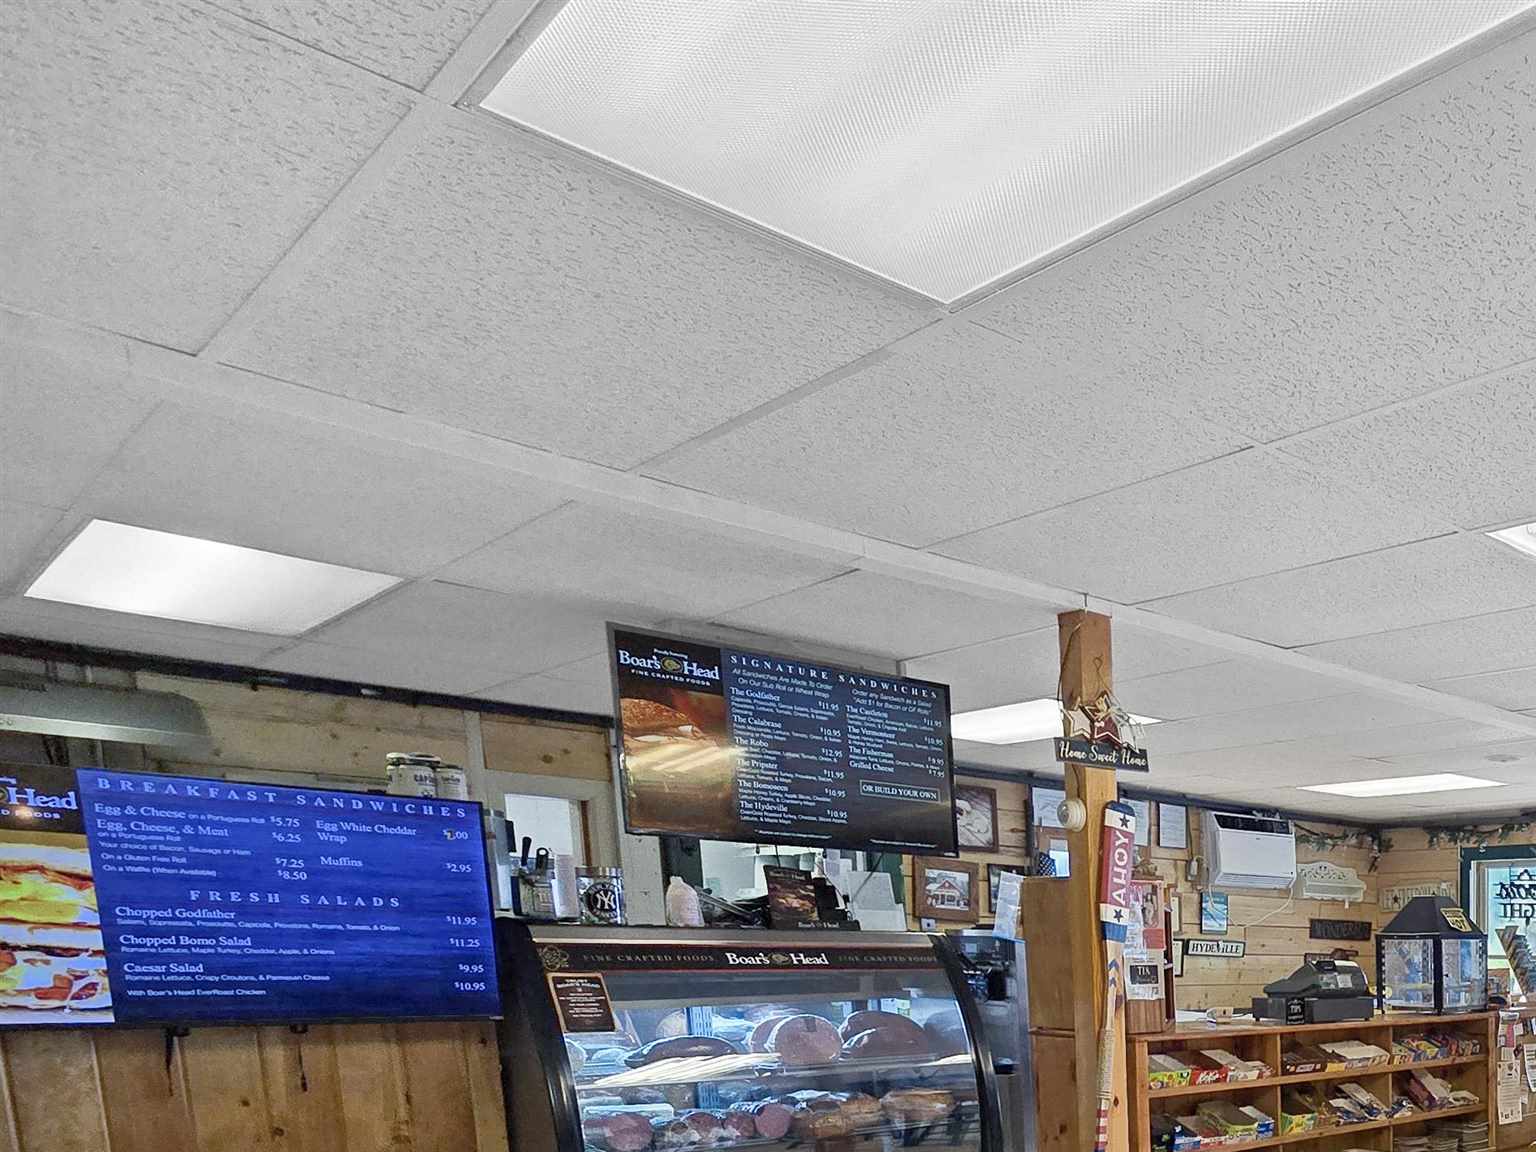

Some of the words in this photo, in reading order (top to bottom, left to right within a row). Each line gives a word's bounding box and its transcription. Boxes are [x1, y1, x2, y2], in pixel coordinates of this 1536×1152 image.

[618, 649, 661, 670] Boar's
[682, 660, 720, 680] Head
[651, 671, 685, 682] CRAFTED
[730, 655, 829, 680] SIGNATURE
[838, 674, 937, 699] SANDWICHES
[729, 686, 745, 697] The
[818, 700, 840, 712] $11.95
[732, 714, 746, 725] The
[734, 736, 749, 746] The
[1060, 740, 1088, 760] Home
[1088, 744, 1120, 764] Sweet
[1120, 747, 1147, 767] Home
[736, 758, 750, 767] The
[738, 778, 752, 788] The
[862, 784, 874, 792] OR
[874, 786, 898, 795] BUILD
[898, 788, 919, 798] YOUR
[919, 791, 938, 799] OWN
[6, 786, 79, 810] Head
[97, 778, 278, 803] BREAKFAST
[296, 794, 466, 818] SANDWICHES
[740, 799, 753, 809] The
[94, 802, 121, 816] Egg
[124, 805, 138, 816] &
[140, 806, 187, 819] Cheese
[270, 815, 300, 828] $5.75
[315, 819, 339, 833] Egg
[339, 821, 373, 834] White
[373, 823, 417, 836] Cheddar
[130, 820, 180, 835] Cheese,
[182, 824, 196, 835] &
[197, 825, 230, 837] Meat
[271, 831, 302, 843] $6.25
[317, 831, 348, 844] Wrap
[275, 856, 305, 868] $7.25
[319, 855, 364, 868] Muffins
[446, 861, 472, 873] $2.95
[1111, 830, 1131, 907] AHOY
[277, 869, 308, 881] $8.50
[189, 889, 281, 904] FRESH
[299, 893, 400, 908] SALADS
[115, 906, 173, 919] Chopped
[174, 907, 237, 919] Godfather
[445, 914, 478, 926] $11.95
[119, 934, 177, 947] Chopped
[179, 935, 217, 946] Bomo
[218, 936, 252, 946] Salad
[450, 937, 481, 948] $11.25
[616, 954, 673, 962] CRAFTED
[725, 952, 770, 965] Boar's
[791, 953, 830, 965] Head
[123, 962, 168, 973] Caesar
[168, 963, 204, 973] Salad
[459, 963, 485, 974] $9.95
[454, 981, 486, 992] $10.95
